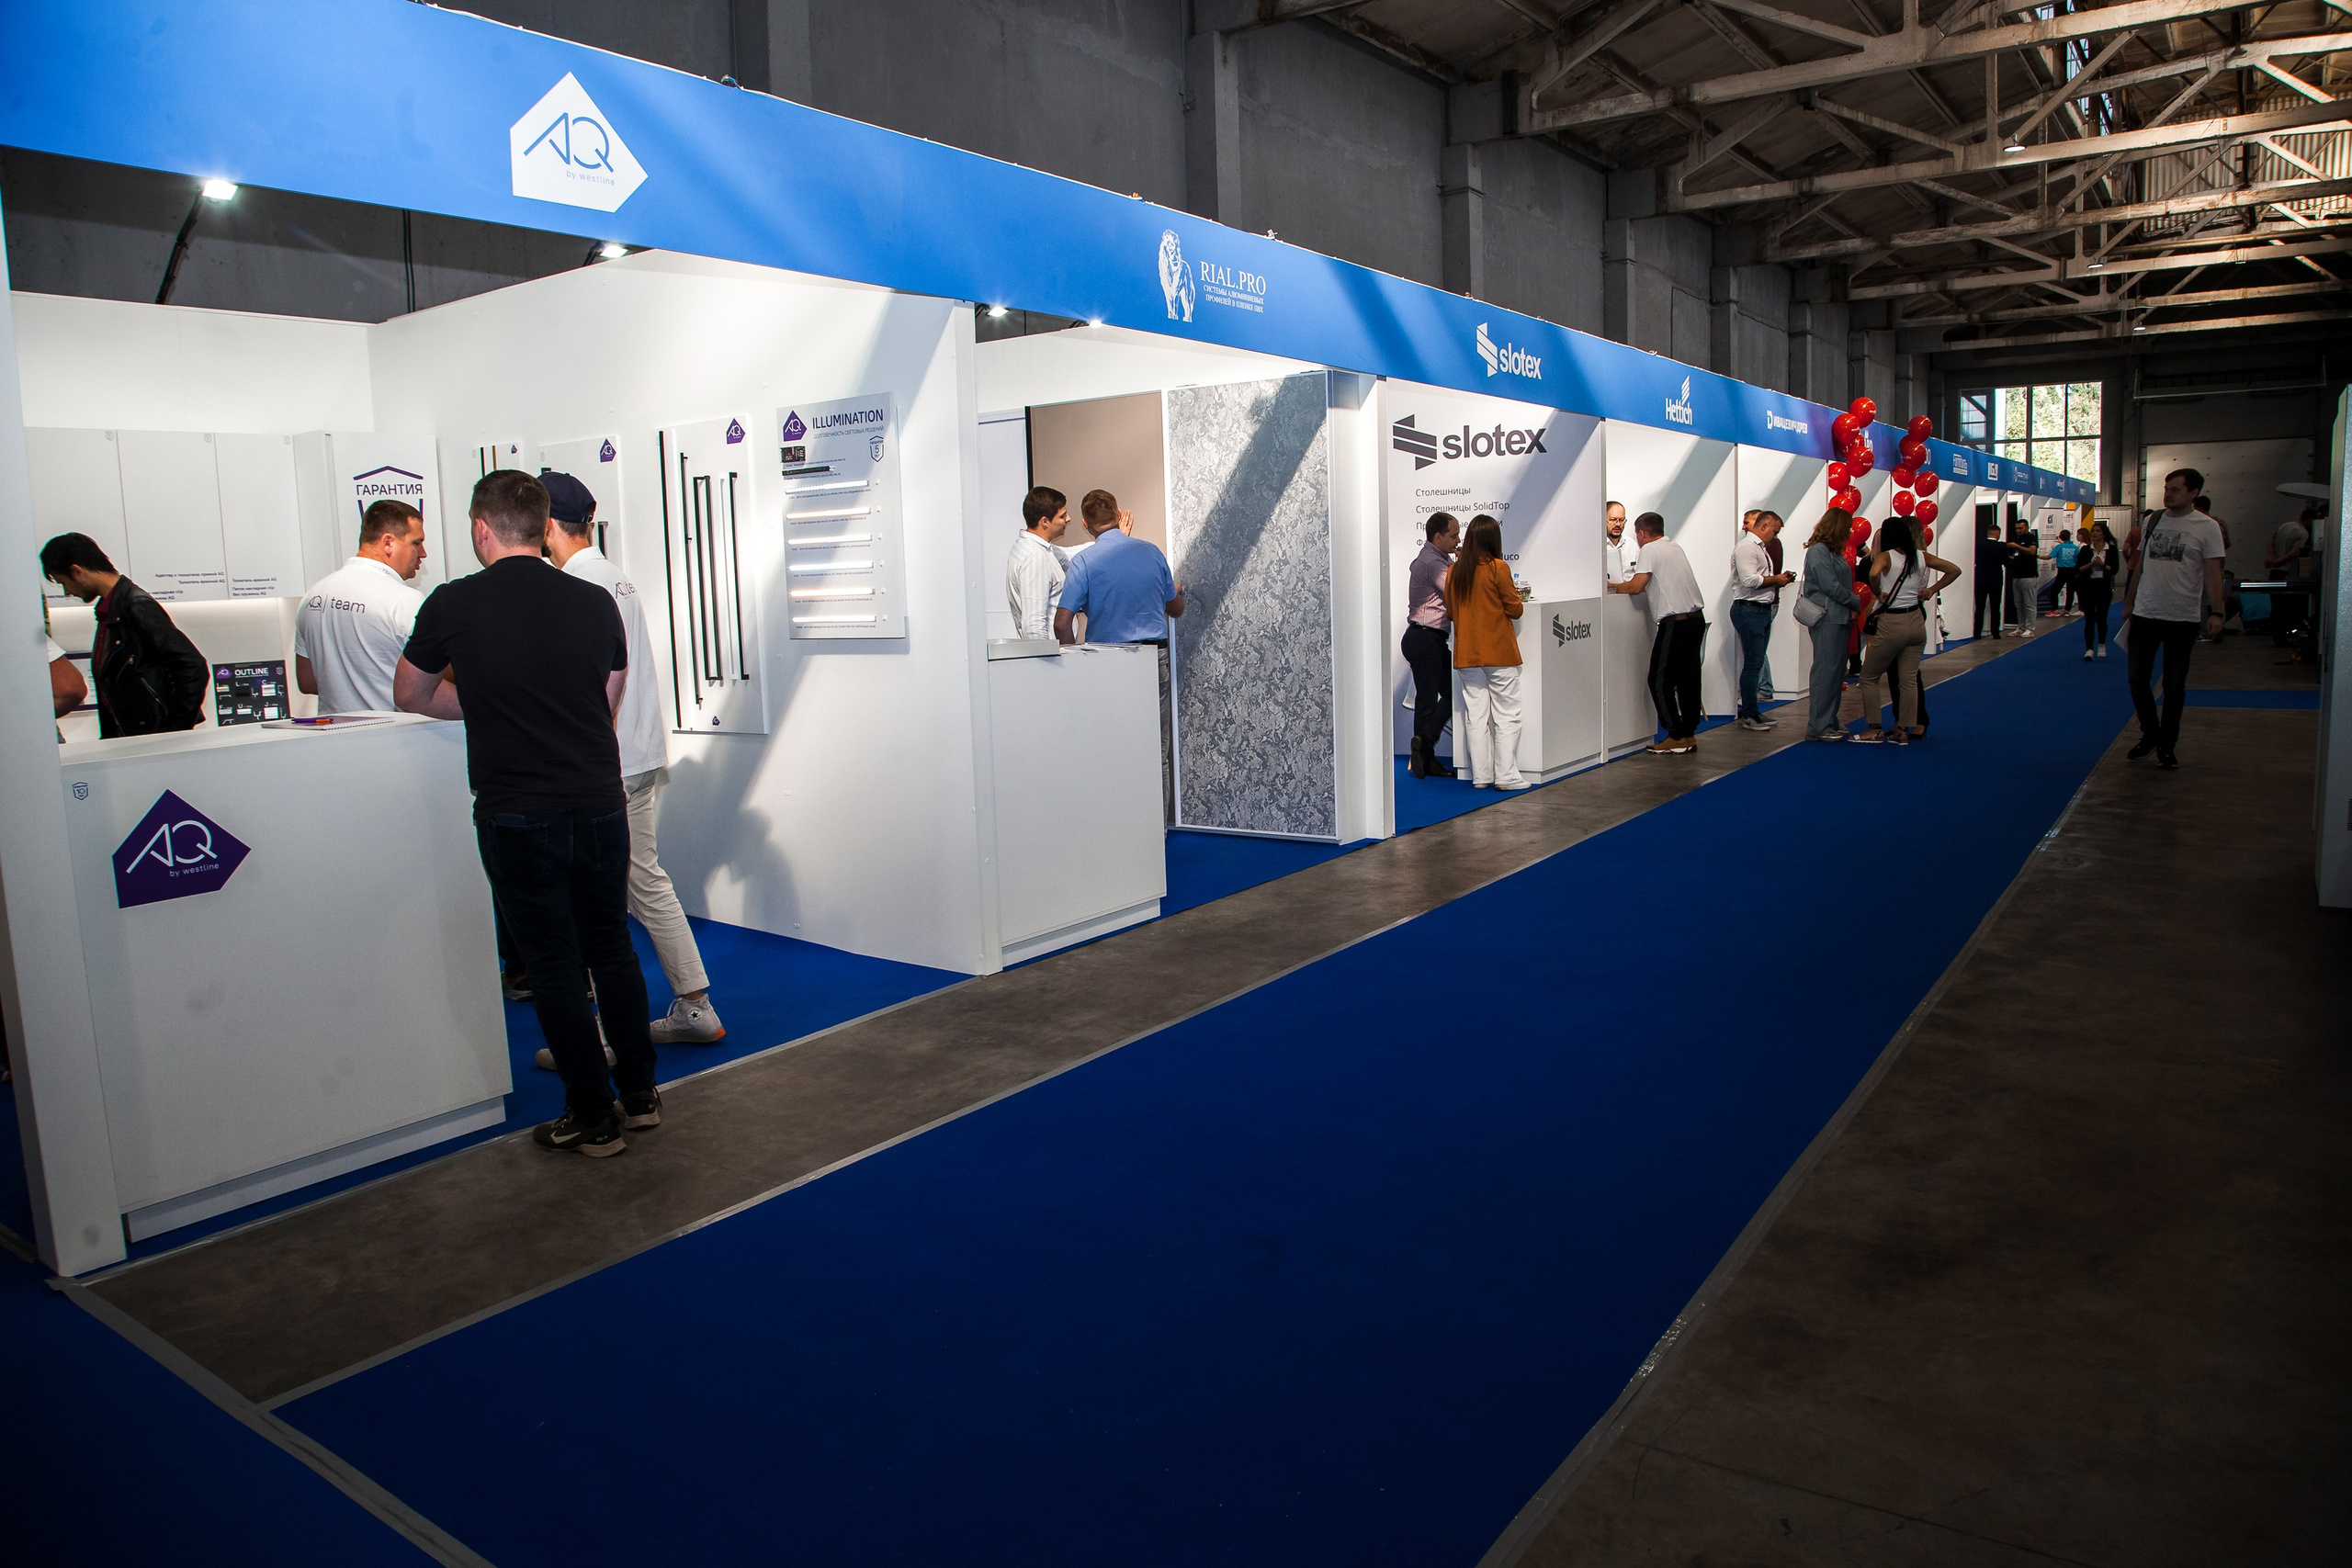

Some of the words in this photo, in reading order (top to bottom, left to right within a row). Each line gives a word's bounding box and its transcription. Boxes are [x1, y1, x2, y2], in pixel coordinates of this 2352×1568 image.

[523, 112, 615, 173] AQ
[566, 169, 576, 179] by
[579, 174, 616, 186] westline
[1200, 261, 1267, 296] RIAL.PRO
[1203, 284, 1227, 297] СИСТЕМЫ
[1499, 342, 1543, 380] slotex
[812, 409, 884, 430] ILLUMINATION
[1665, 398, 1693, 425] Hettich
[1442, 423, 1547, 459] slotex
[356, 483, 424, 496] ГАРАНТИЯ
[1415, 487, 1471, 498] Столешницы
[1416, 505, 1471, 513] Столешницы
[1473, 501, 1510, 513] SolidTop
[331, 596, 366, 614] team
[1566, 620, 1591, 641] slotex
[234, 668, 269, 676] OUTLINE
[126, 819, 218, 874] AQ
[182, 863, 220, 875] westline
